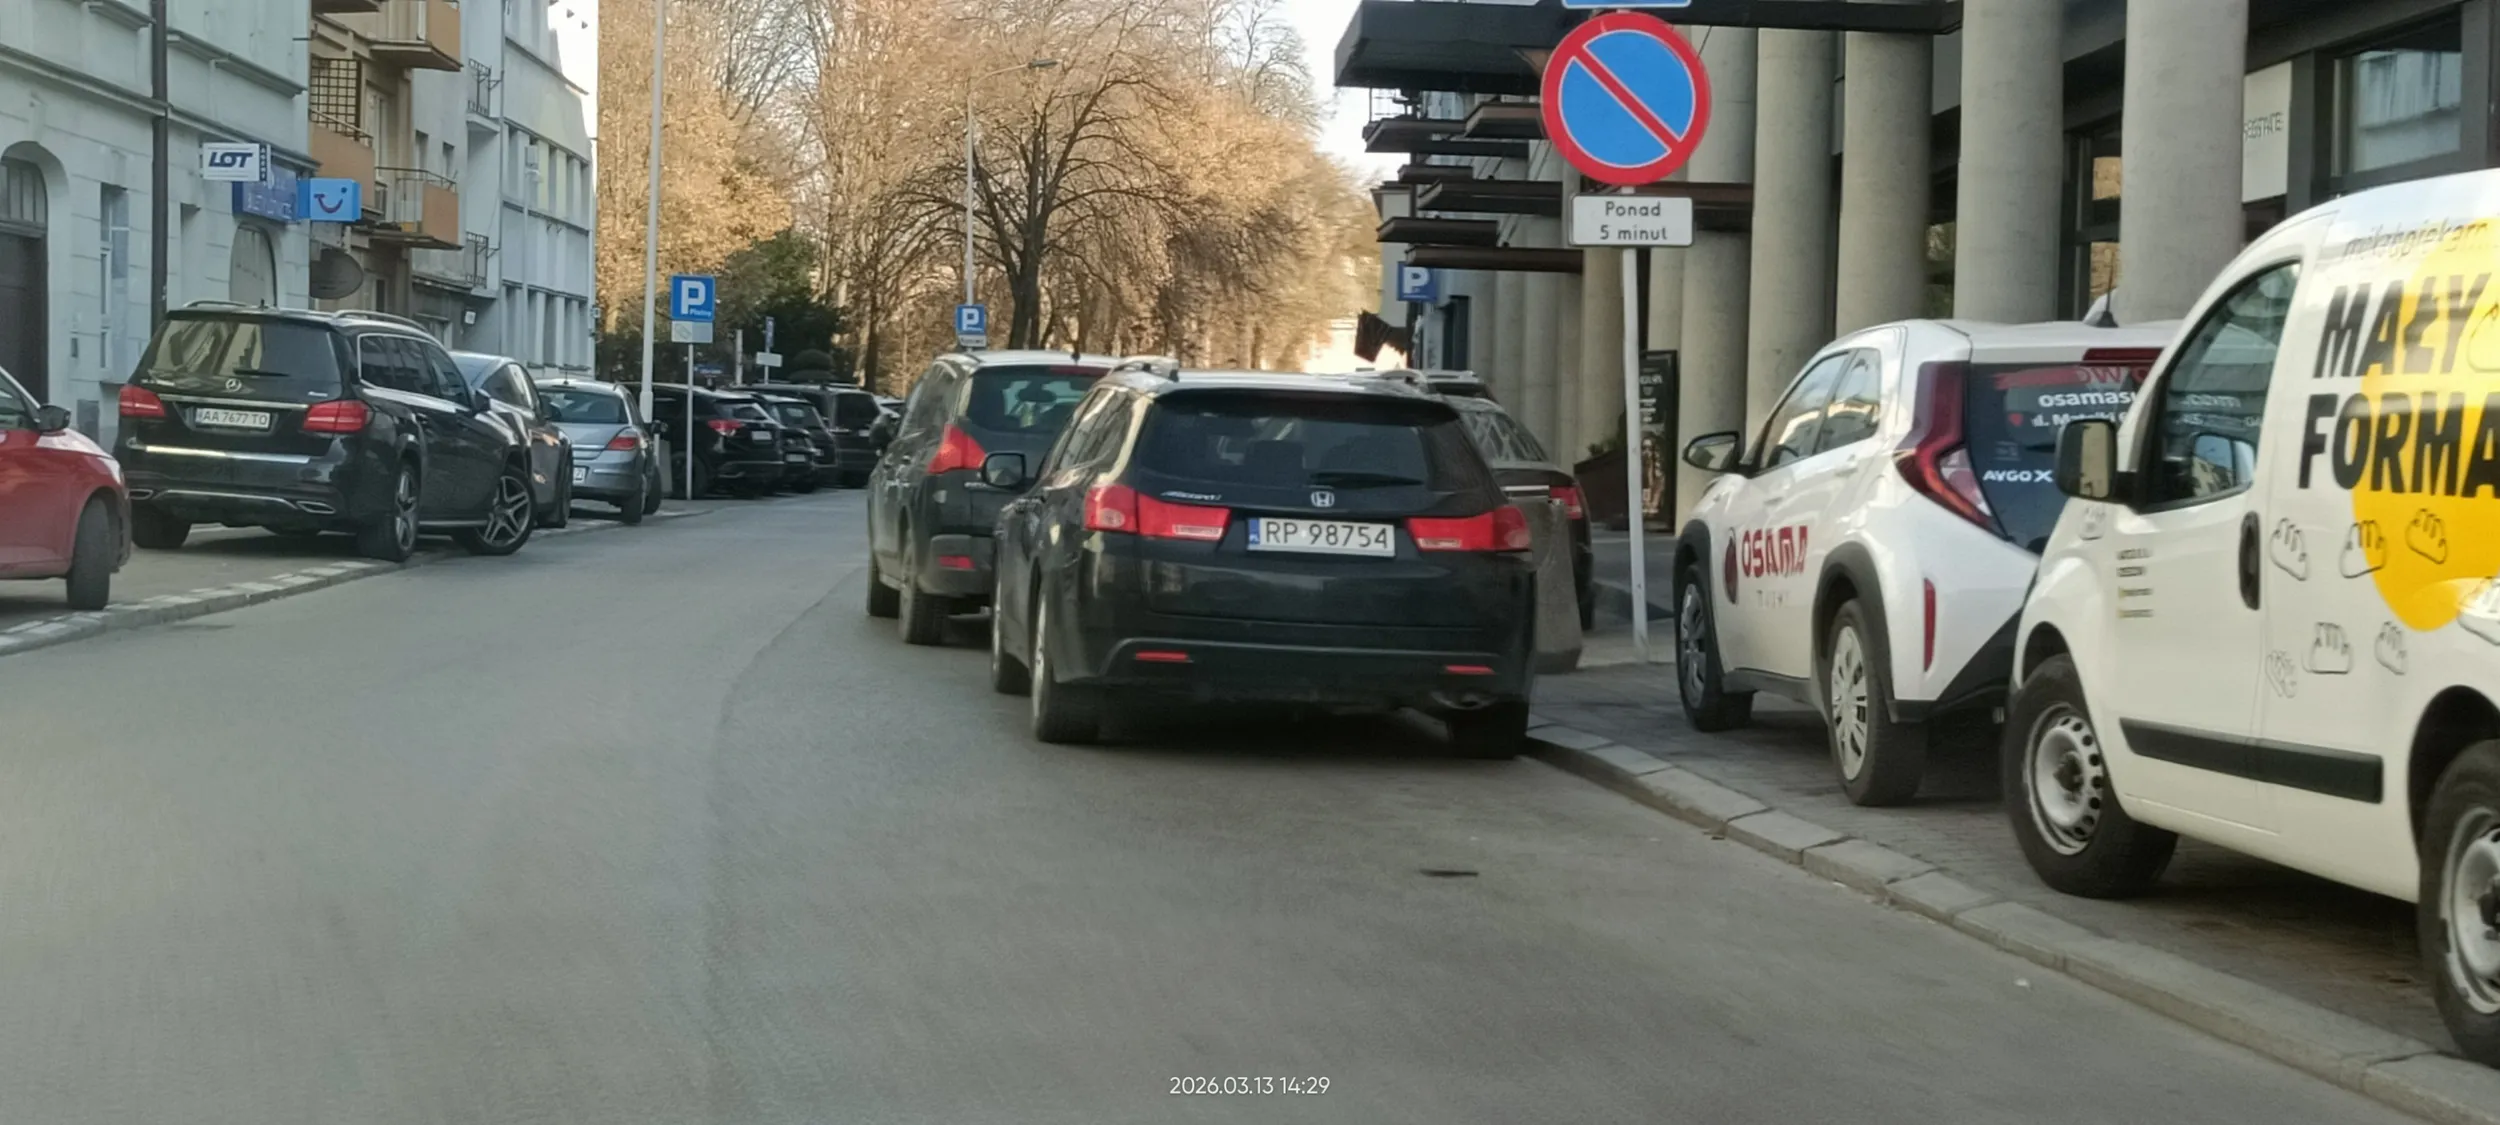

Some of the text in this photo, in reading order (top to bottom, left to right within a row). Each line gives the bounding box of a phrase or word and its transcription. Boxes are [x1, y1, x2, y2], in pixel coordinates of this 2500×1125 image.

[208, 152, 253, 168] LOT
[1605, 200, 1661, 216] Ponad
[1600, 224, 1667, 241] 5 minut
[1403, 266, 1430, 294] P
[681, 280, 706, 315] P
[961, 308, 979, 331] P
[2312, 272, 2493, 379] MAŁY
[203, 411, 220, 422] AA
[222, 412, 249, 424] 7677
[1983, 470, 2053, 482] AYGO X
[1266, 521, 1298, 544] RP
[1308, 524, 1388, 549] 98754
[1742, 526, 1808, 578] OSAMA
